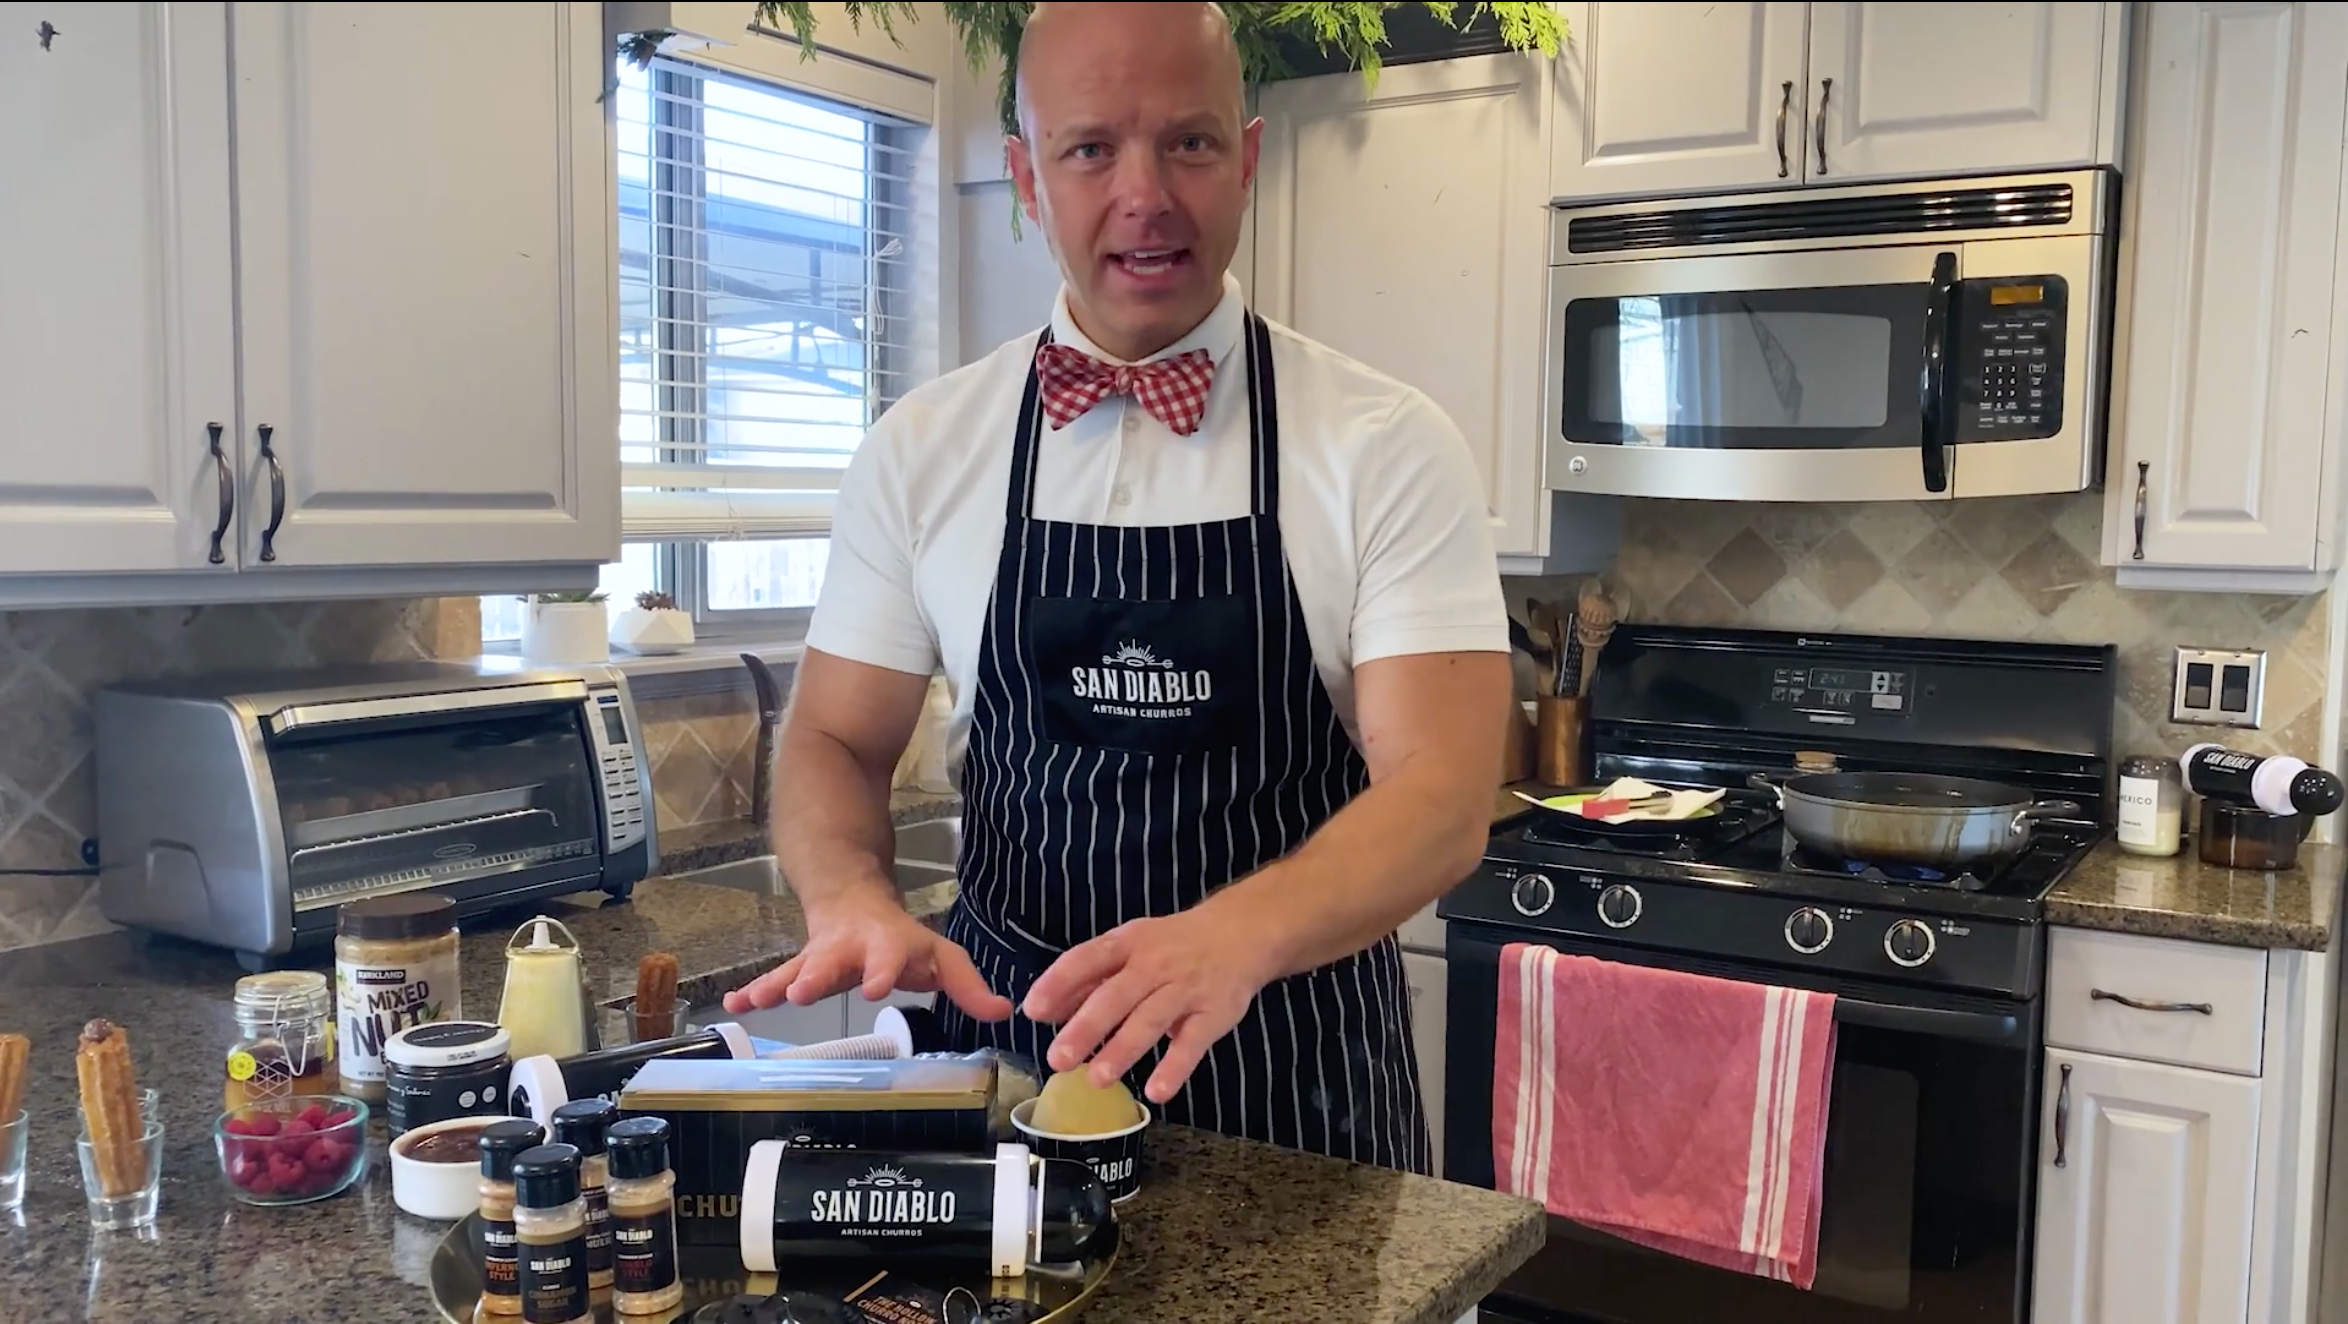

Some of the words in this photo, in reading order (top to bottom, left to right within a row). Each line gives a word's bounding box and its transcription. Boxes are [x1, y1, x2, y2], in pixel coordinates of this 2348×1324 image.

[1071, 666, 1119, 700] SAN
[1123, 669, 1212, 703] DIABLO
[1092, 704, 1137, 717] ARTISAN
[1140, 707, 1192, 719] CHURROS
[2203, 752, 2226, 766] SAN
[2220, 755, 2256, 770] DIABLO
[357, 971, 405, 980] KIRKLAND
[1094, 1157, 1133, 1183] IABLO
[677, 1194, 739, 1218] CHU
[811, 1190, 862, 1222] SAN
[868, 1190, 956, 1223] DIABLO
[841, 1228, 879, 1237] ARTISAN
[881, 1228, 923, 1237] CHURROS
[530, 1260, 544, 1271] SAN
[545, 1257, 571, 1271] DIABLO
[490, 1271, 516, 1281] STYLE
[857, 1299, 900, 1321] CHURRO
[893, 1303, 939, 1324] HOLLOW
